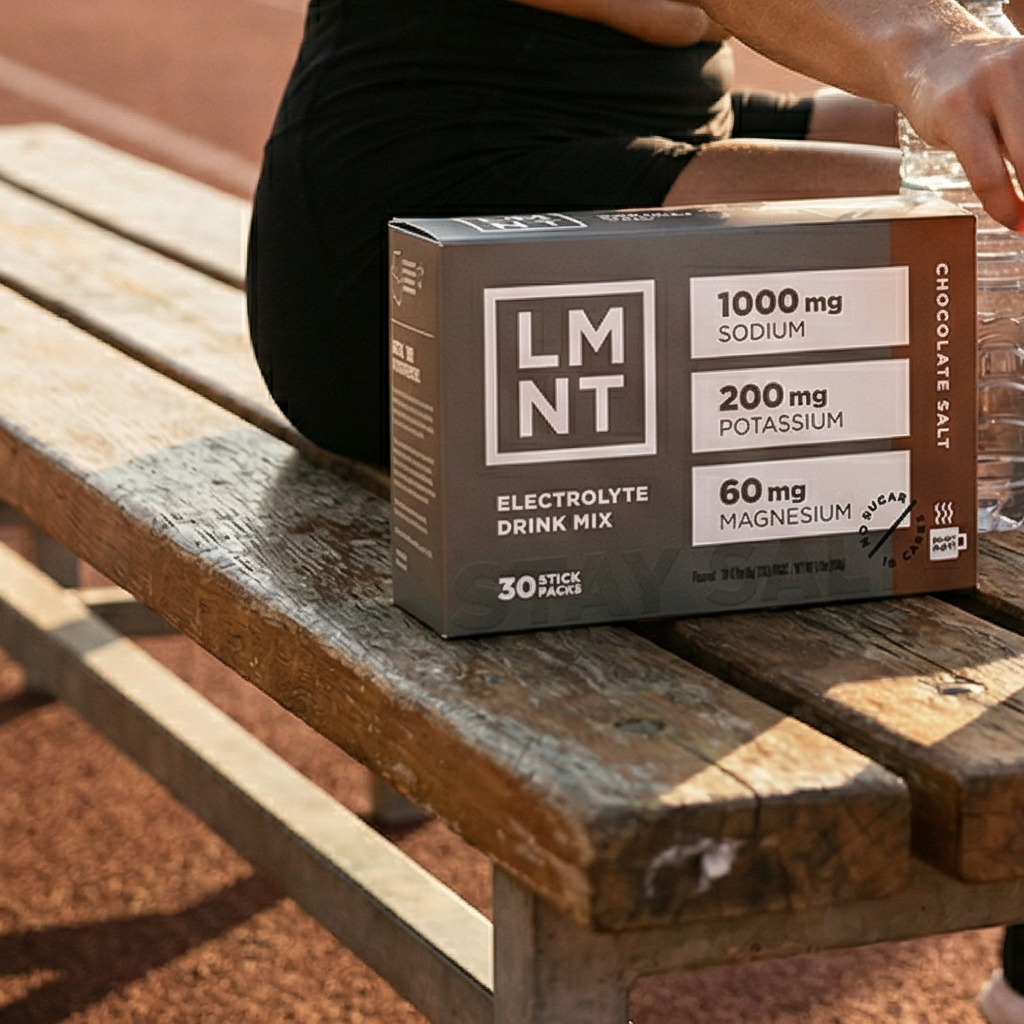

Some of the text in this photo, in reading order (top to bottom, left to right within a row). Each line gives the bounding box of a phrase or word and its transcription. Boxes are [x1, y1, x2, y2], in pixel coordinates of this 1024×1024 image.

[717, 288, 843, 318] 1000 mg
[718, 321, 805, 343] SODIUM
[936, 263, 950, 449] CHOCOLATE SALT
[719, 382, 828, 412] 200 mg
[719, 411, 844, 437] POTASSIUM
[497, 486, 649, 512] ELECTROLYTE
[719, 477, 806, 505] 60 mg
[497, 512, 613, 536] DRINK MIX
[720, 503, 852, 530] MAGNESIUM
[497, 575, 537, 601] 30
[538, 571, 581, 586] STICK
[538, 584, 582, 597] PACKS
